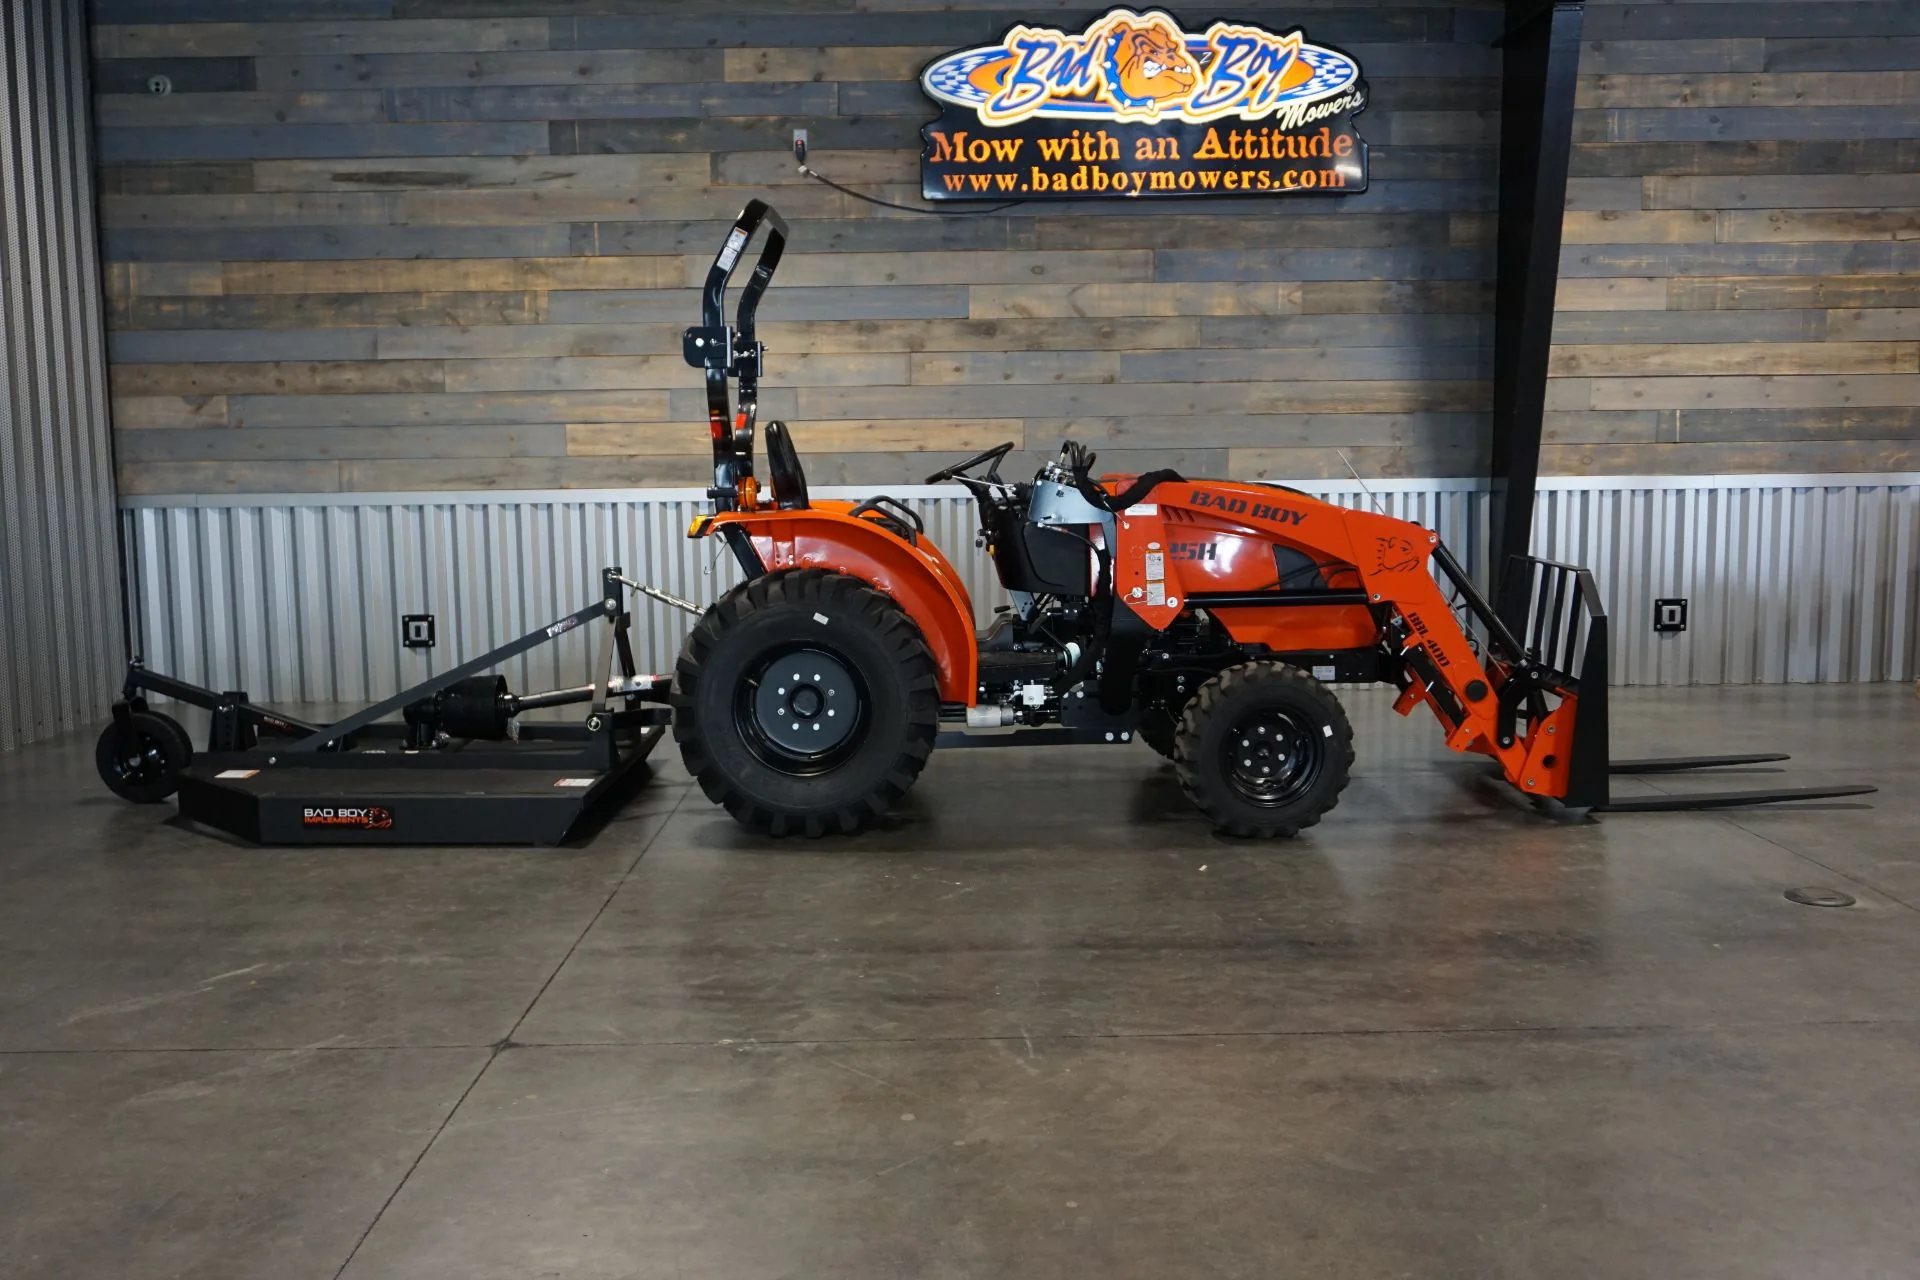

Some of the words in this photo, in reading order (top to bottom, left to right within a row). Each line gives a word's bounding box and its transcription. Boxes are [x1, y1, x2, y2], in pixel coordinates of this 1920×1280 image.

[988, 33, 1104, 115] Bad
[1187, 32, 1296, 112] Boy
[1276, 92, 1364, 131] Mowers
[929, 131, 1023, 163] Mow
[1037, 129, 1121, 163] with
[1135, 136, 1180, 161] an
[1193, 127, 1353, 160] Attitude
[943, 165, 1345, 196] www.badboymowers.com
[1190, 490, 1247, 514] BAD
[1251, 503, 1308, 525] BOY
[304, 808, 334, 817] BAD
[338, 808, 367, 817] BOY
